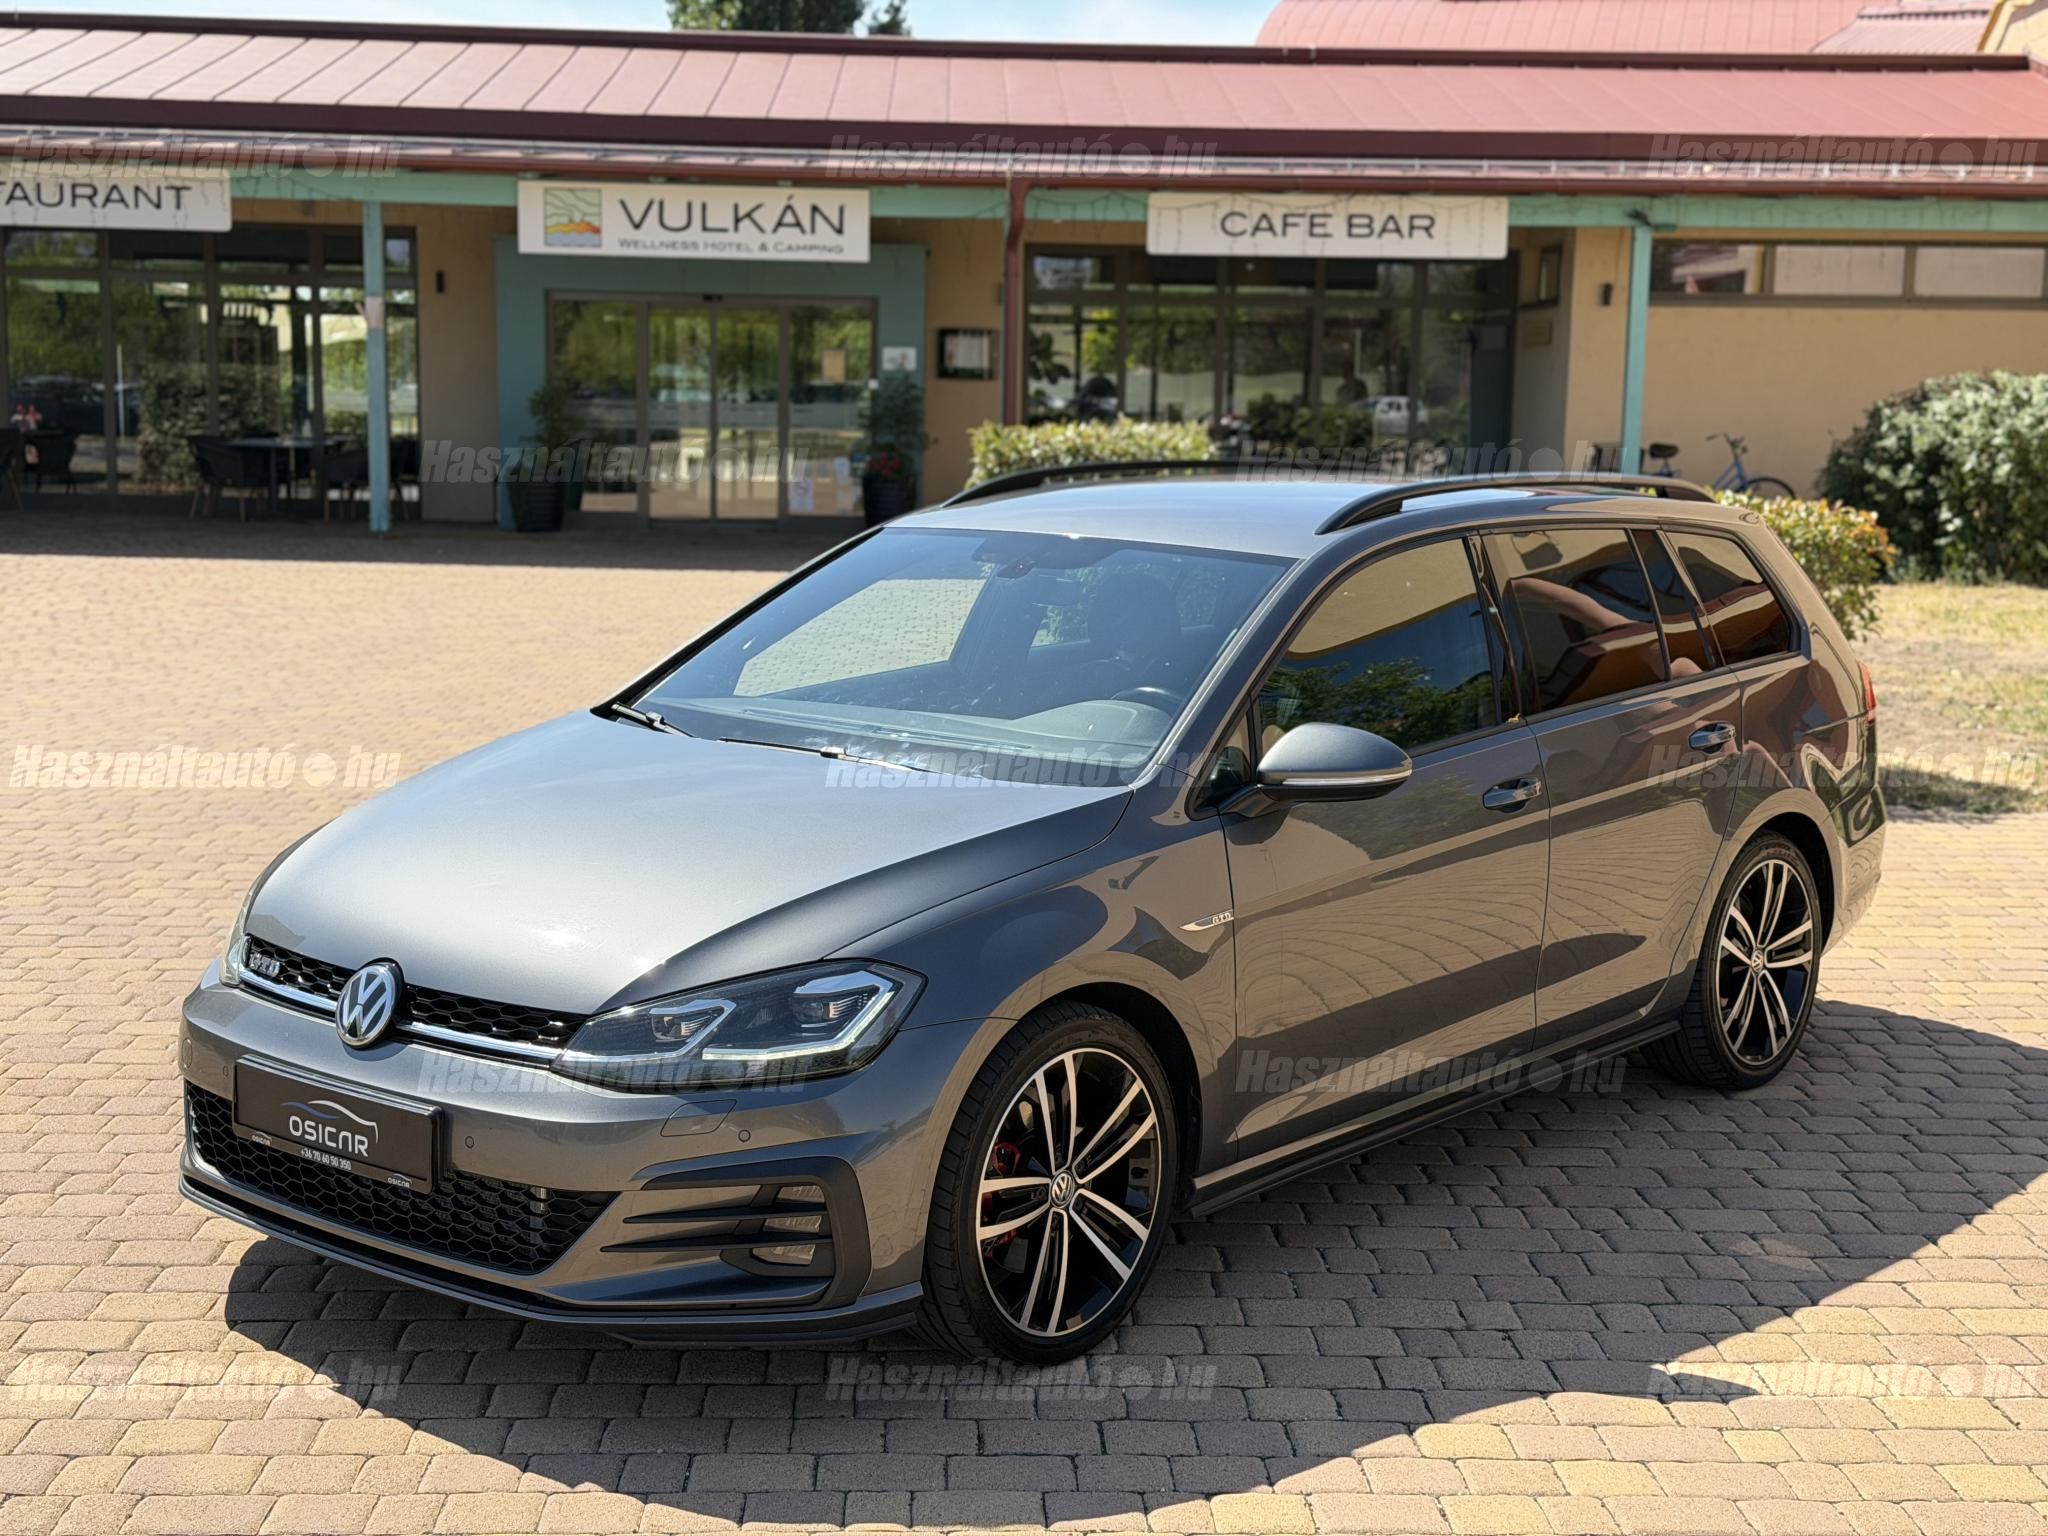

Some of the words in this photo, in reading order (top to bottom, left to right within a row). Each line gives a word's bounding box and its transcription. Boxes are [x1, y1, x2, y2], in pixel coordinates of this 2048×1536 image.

[618, 193, 845, 235] VULKÁN
[1347, 213, 1436, 240] BAR
[617, 238, 699, 251] WELLNESS
[703, 239, 753, 252] HOTEL
[757, 241, 770, 252] &
[773, 241, 844, 254] CAMPING
[289, 1115, 369, 1157] OSICAR
[313, 1151, 321, 1160] 70
